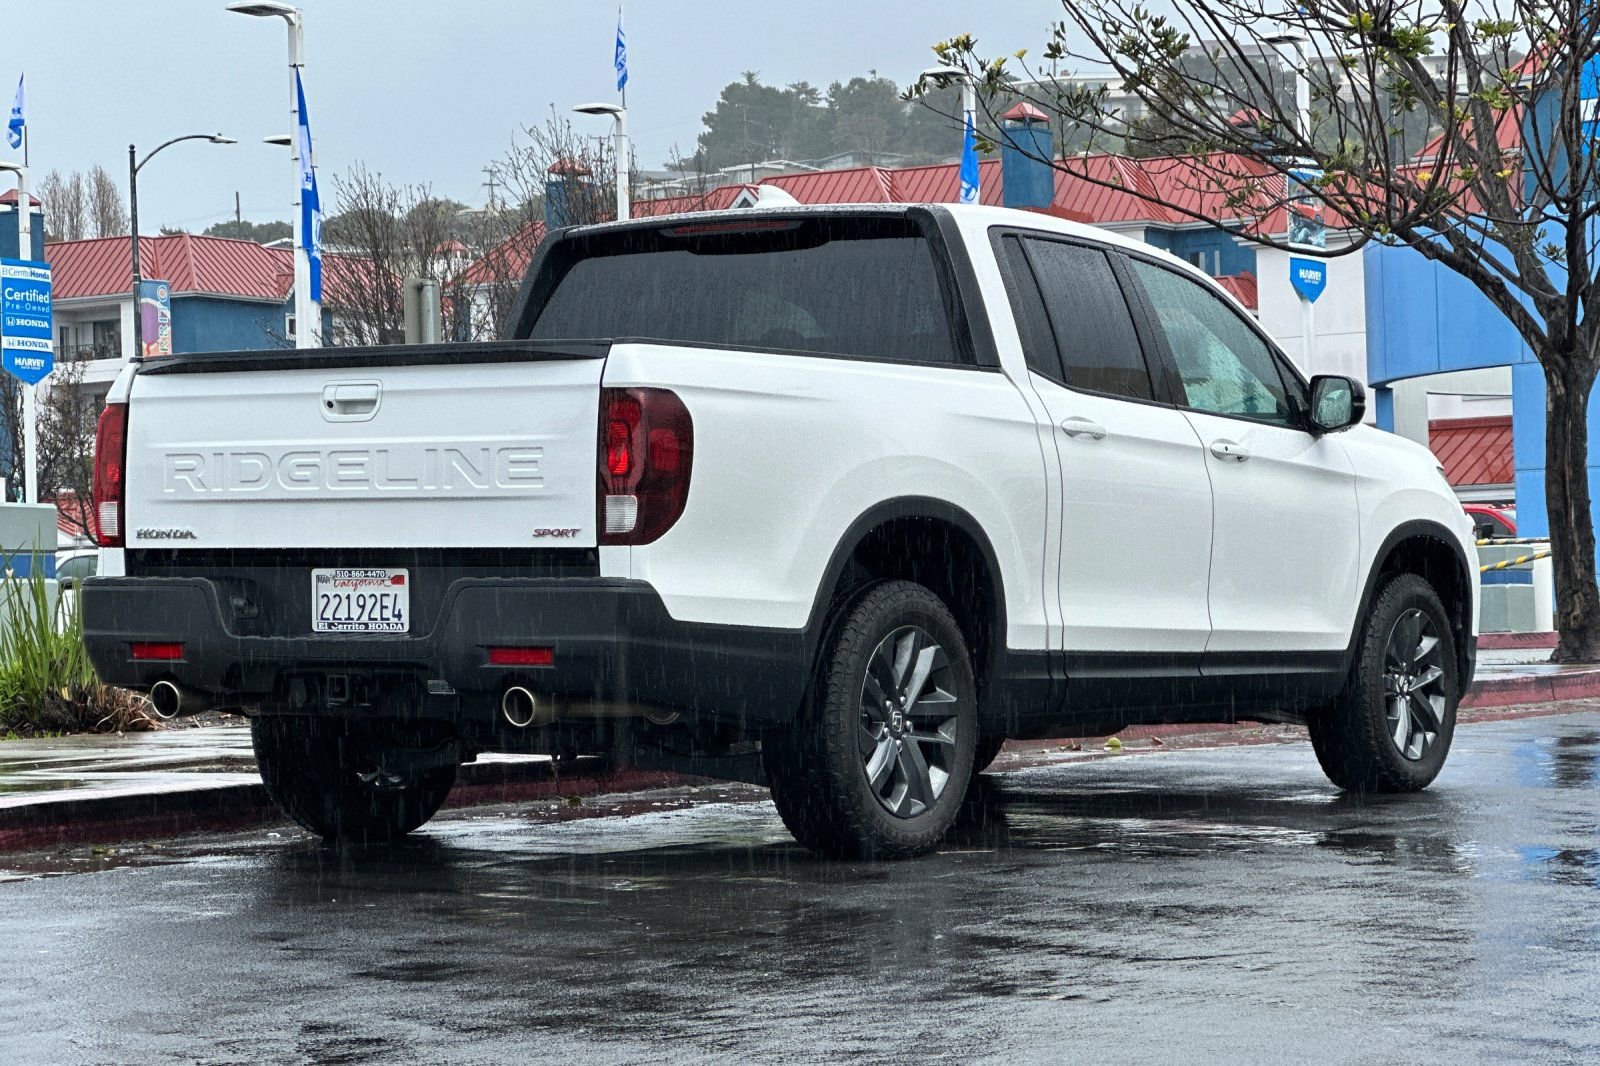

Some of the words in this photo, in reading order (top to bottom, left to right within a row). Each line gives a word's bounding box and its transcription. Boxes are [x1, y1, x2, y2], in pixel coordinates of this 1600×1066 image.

[5, 287, 49, 304] Certified
[6, 301, 49, 313] Pre-Owned
[16, 318, 49, 328] HONDA
[17, 340, 49, 348] HONDA
[14, 357, 45, 367] HARVEY
[163, 447, 543, 492] RIDGELINE
[136, 529, 197, 539] HONDA
[532, 528, 581, 538] SPORT
[336, 570, 385, 578] 510-860-4470
[333, 578, 385, 592] California
[320, 593, 403, 621] 22192E4
[318, 622, 329, 630] El
[331, 622, 366, 630] Cerrito
[368, 622, 403, 630] HONDA
